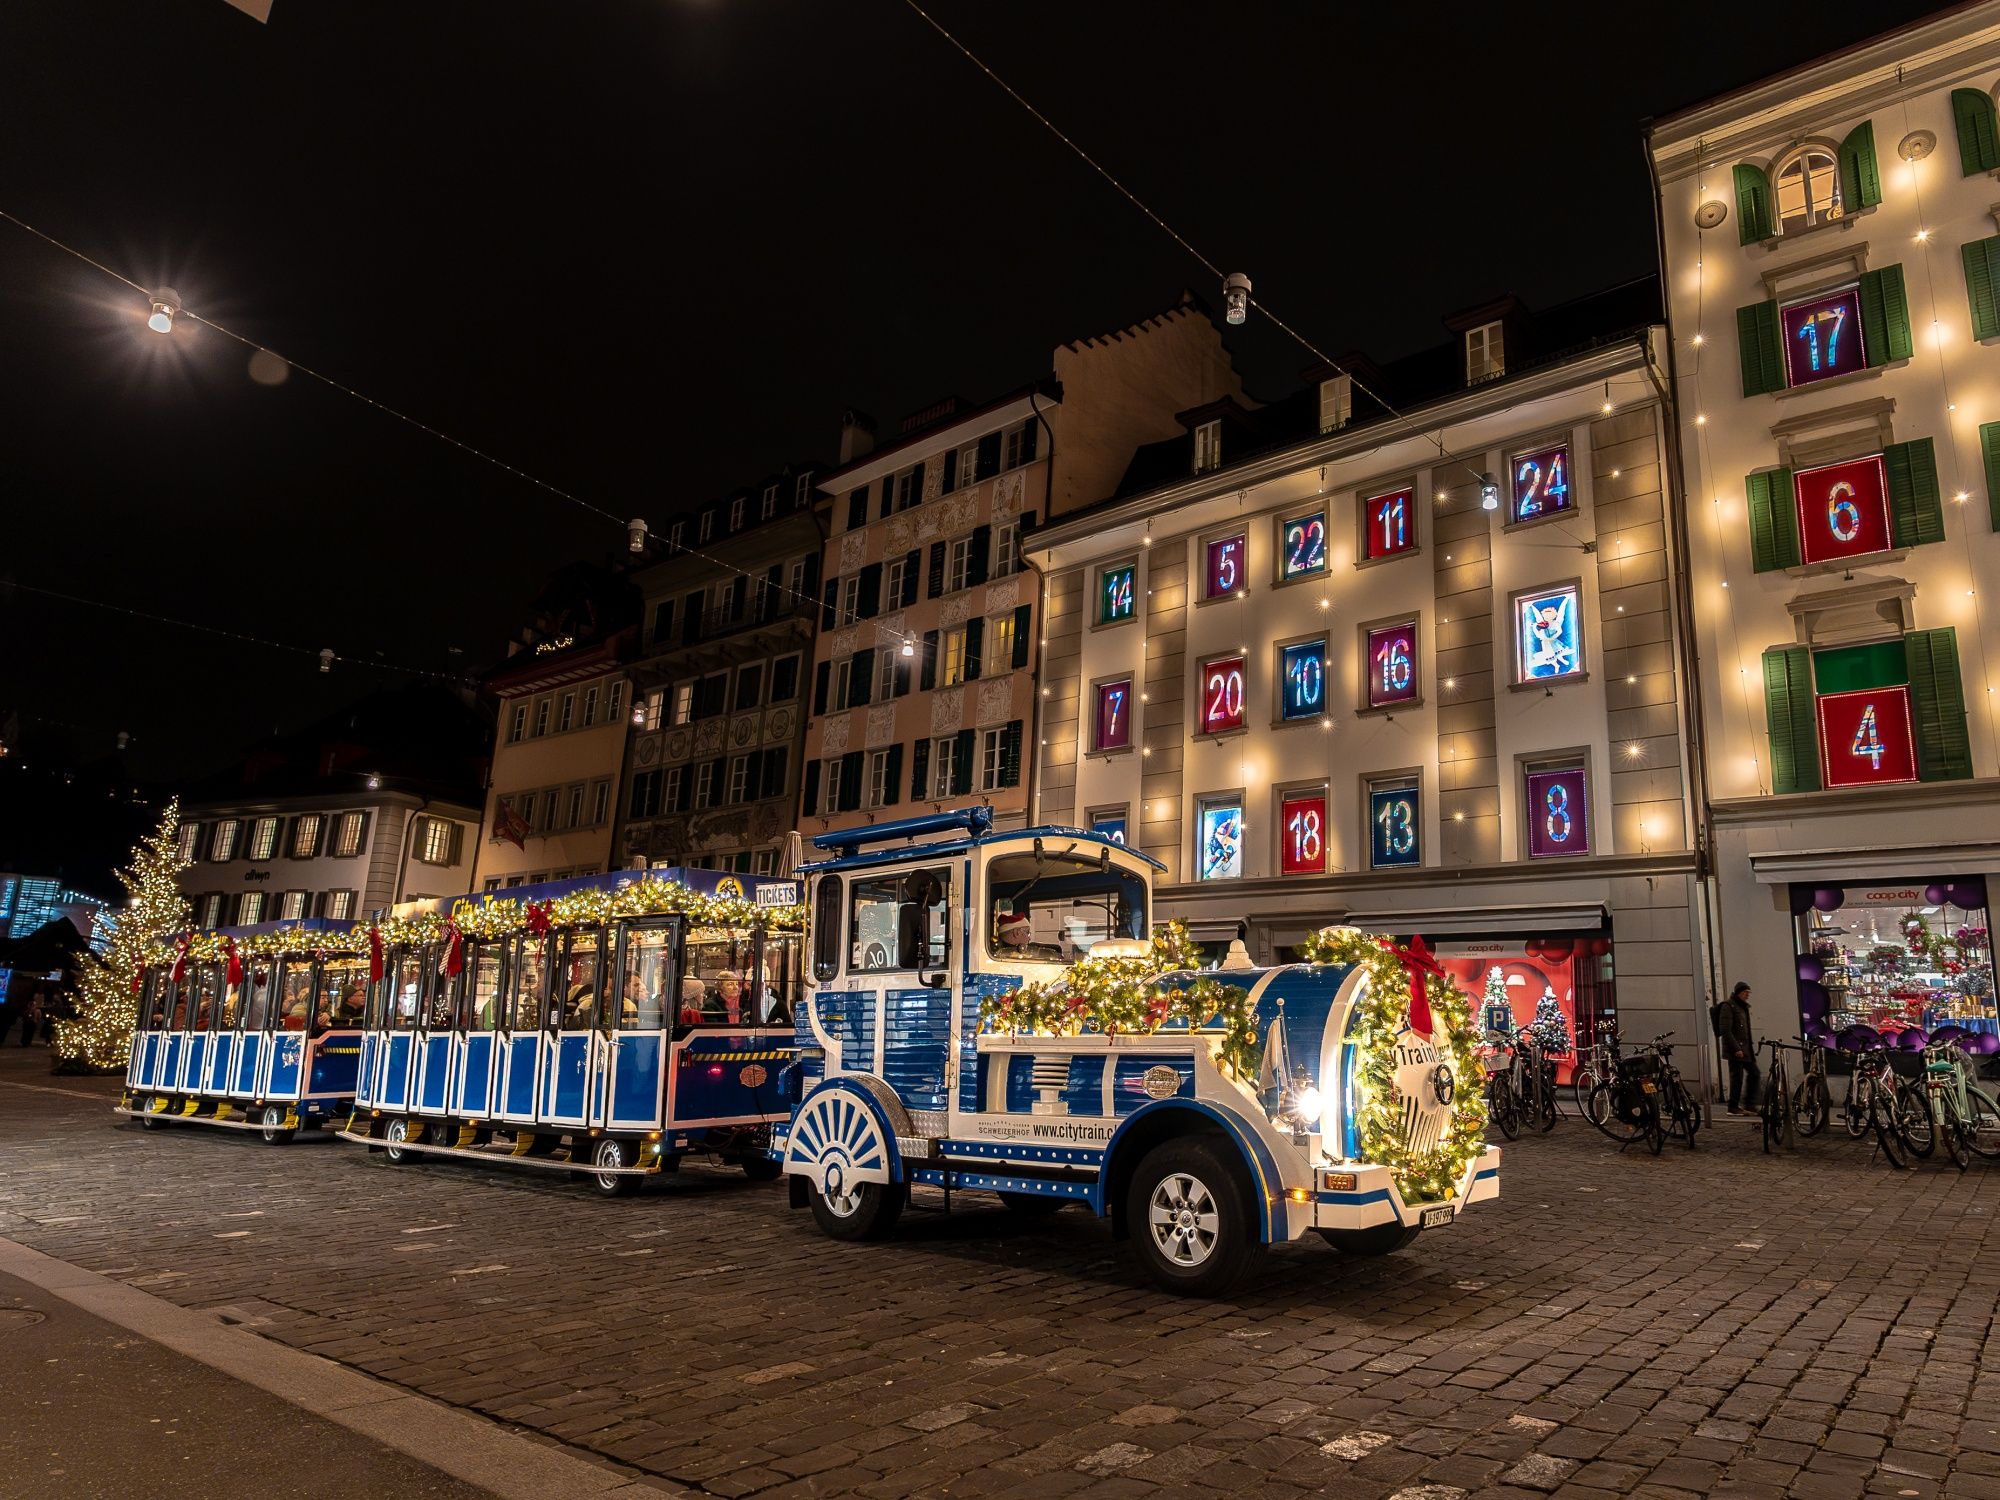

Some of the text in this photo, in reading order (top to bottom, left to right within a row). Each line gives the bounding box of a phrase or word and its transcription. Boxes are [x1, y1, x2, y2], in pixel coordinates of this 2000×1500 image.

[1799, 304, 1846, 370] 17
[1518, 453, 1567, 514] 24
[1378, 497, 1406, 548] 11
[1829, 482, 1860, 541] 6
[1218, 543, 1236, 589] 5
[1287, 521, 1326, 573] 22
[1108, 573, 1133, 617] 14
[1290, 657, 1321, 706] 10
[1375, 639, 1411, 691] 16
[1109, 691, 1122, 735] 7
[1209, 671, 1243, 721] 20
[1852, 705, 1885, 770] 4
[1290, 810, 1321, 861] 18
[1378, 801, 1414, 856] 13
[1547, 785, 1570, 842] 8
[757, 887, 795, 904] TICKETS
[1866, 890, 1920, 901] coop city
[1468, 944, 1504, 953] coop city
[1493, 1010, 1504, 1028] P
[978, 1127, 1030, 1136] SCHWEIZERHOF
